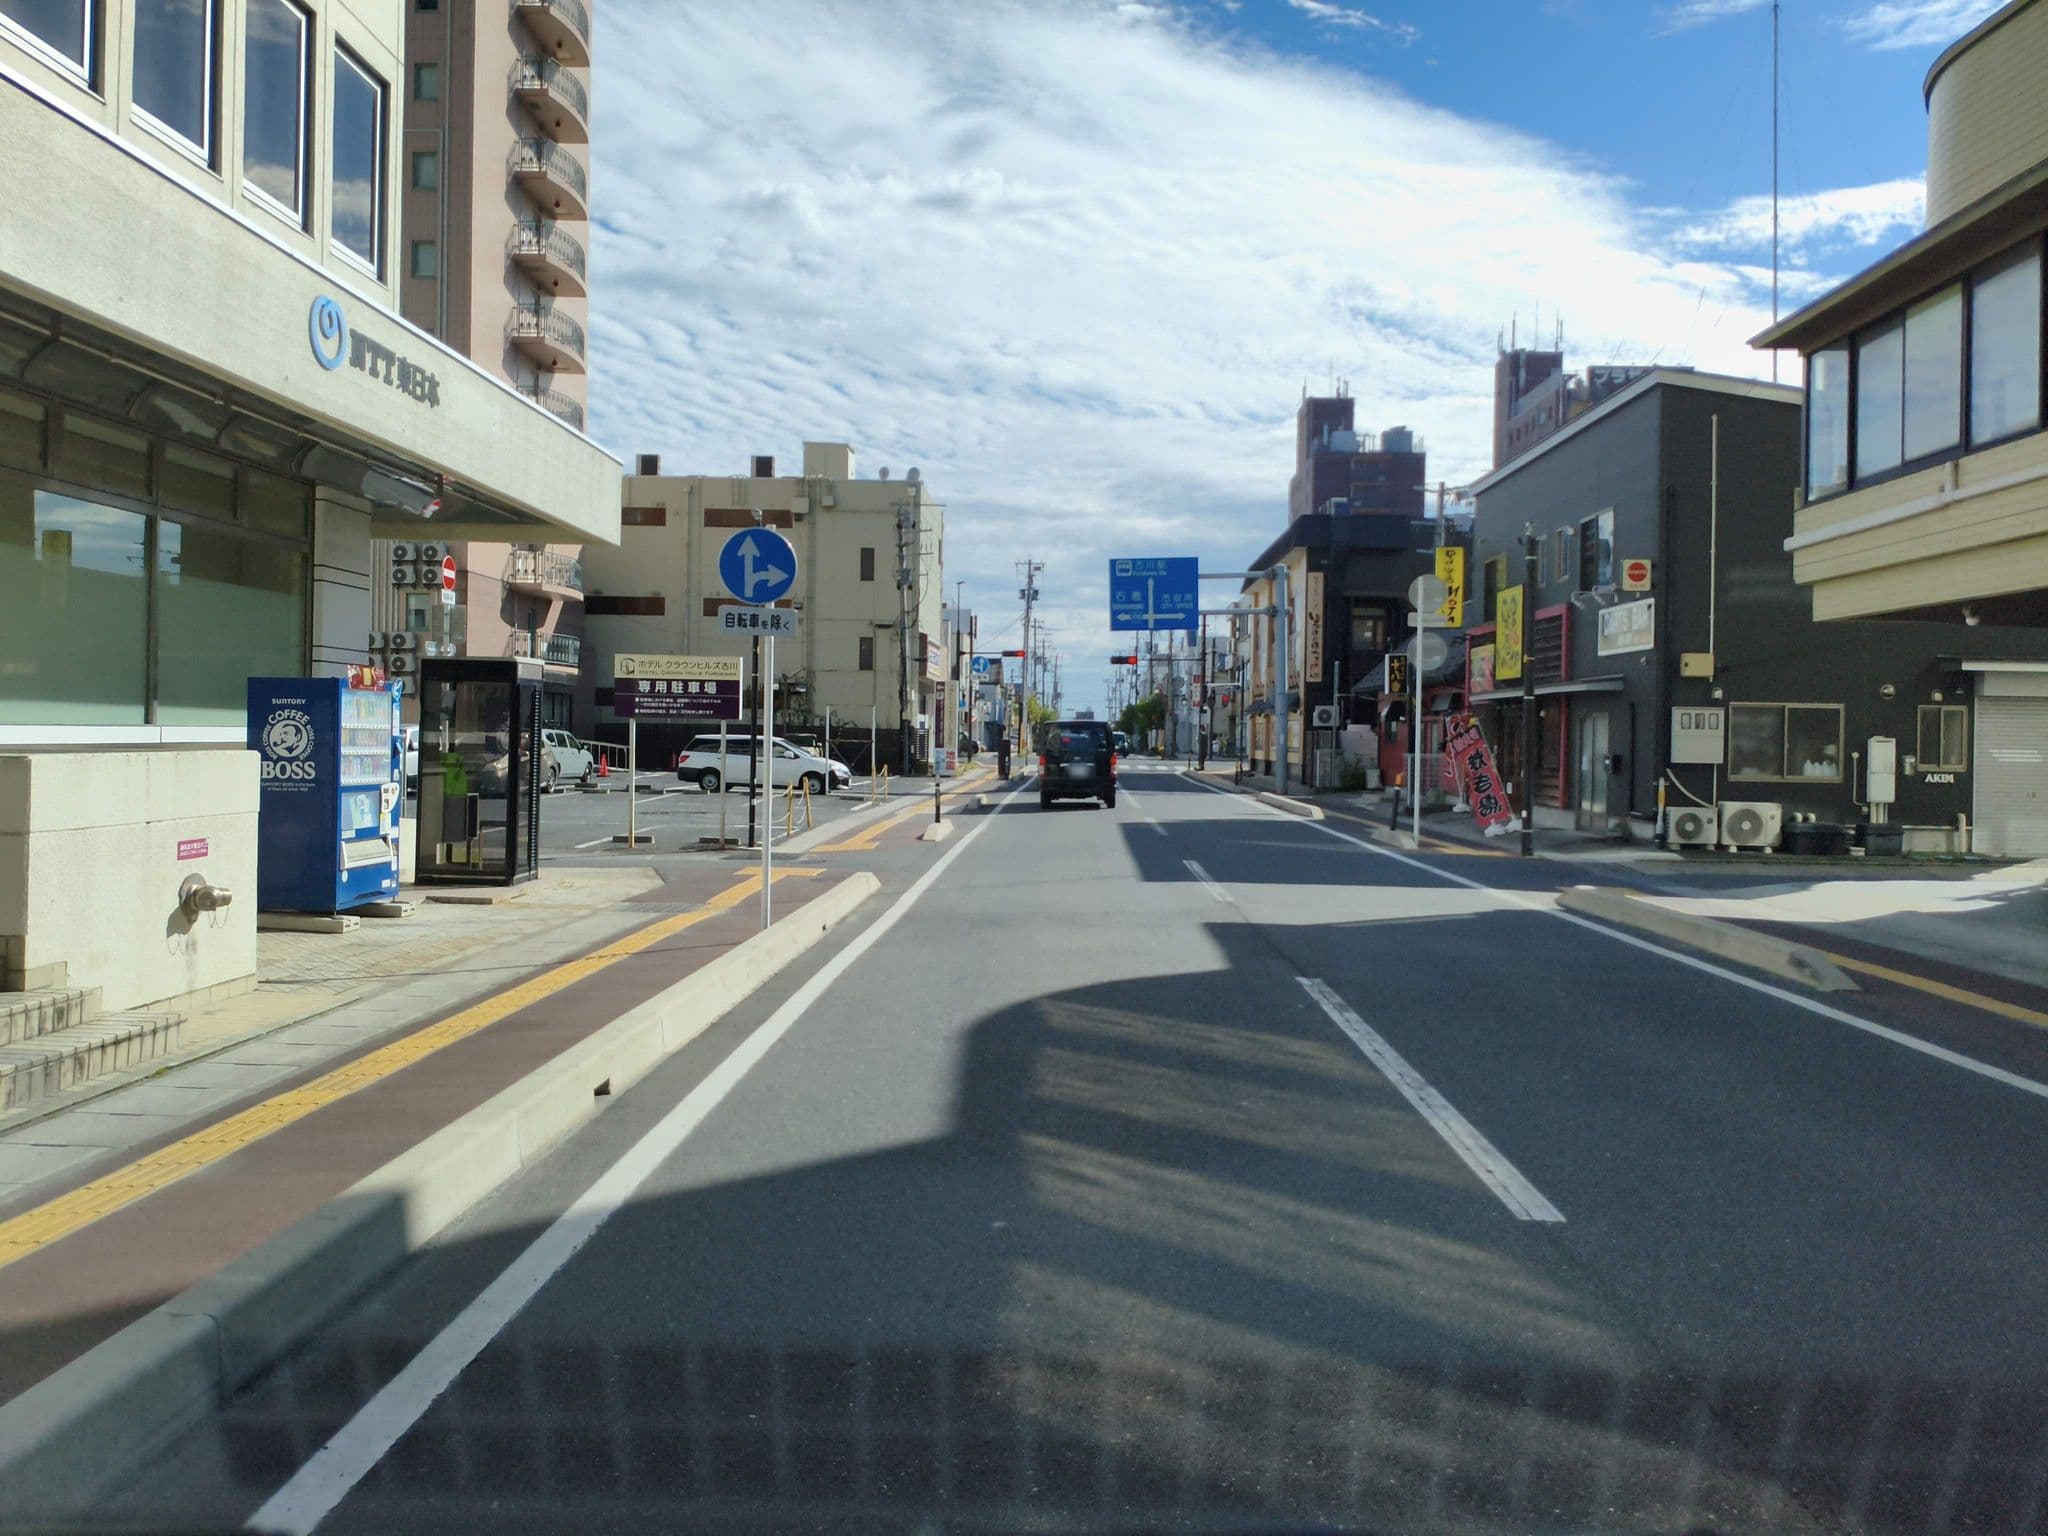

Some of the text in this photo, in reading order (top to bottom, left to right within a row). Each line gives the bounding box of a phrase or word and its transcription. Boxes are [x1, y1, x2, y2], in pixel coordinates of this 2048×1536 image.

[349, 328, 440, 408] NTT東日本
[725, 612, 789, 631] 自転車を除く
[638, 660, 738, 671] ホテル クラウンヒルズ古川
[638, 680, 717, 694] 専用駐車場
[268, 709, 310, 725] COFFEE
[261, 761, 316, 779] BOSS
